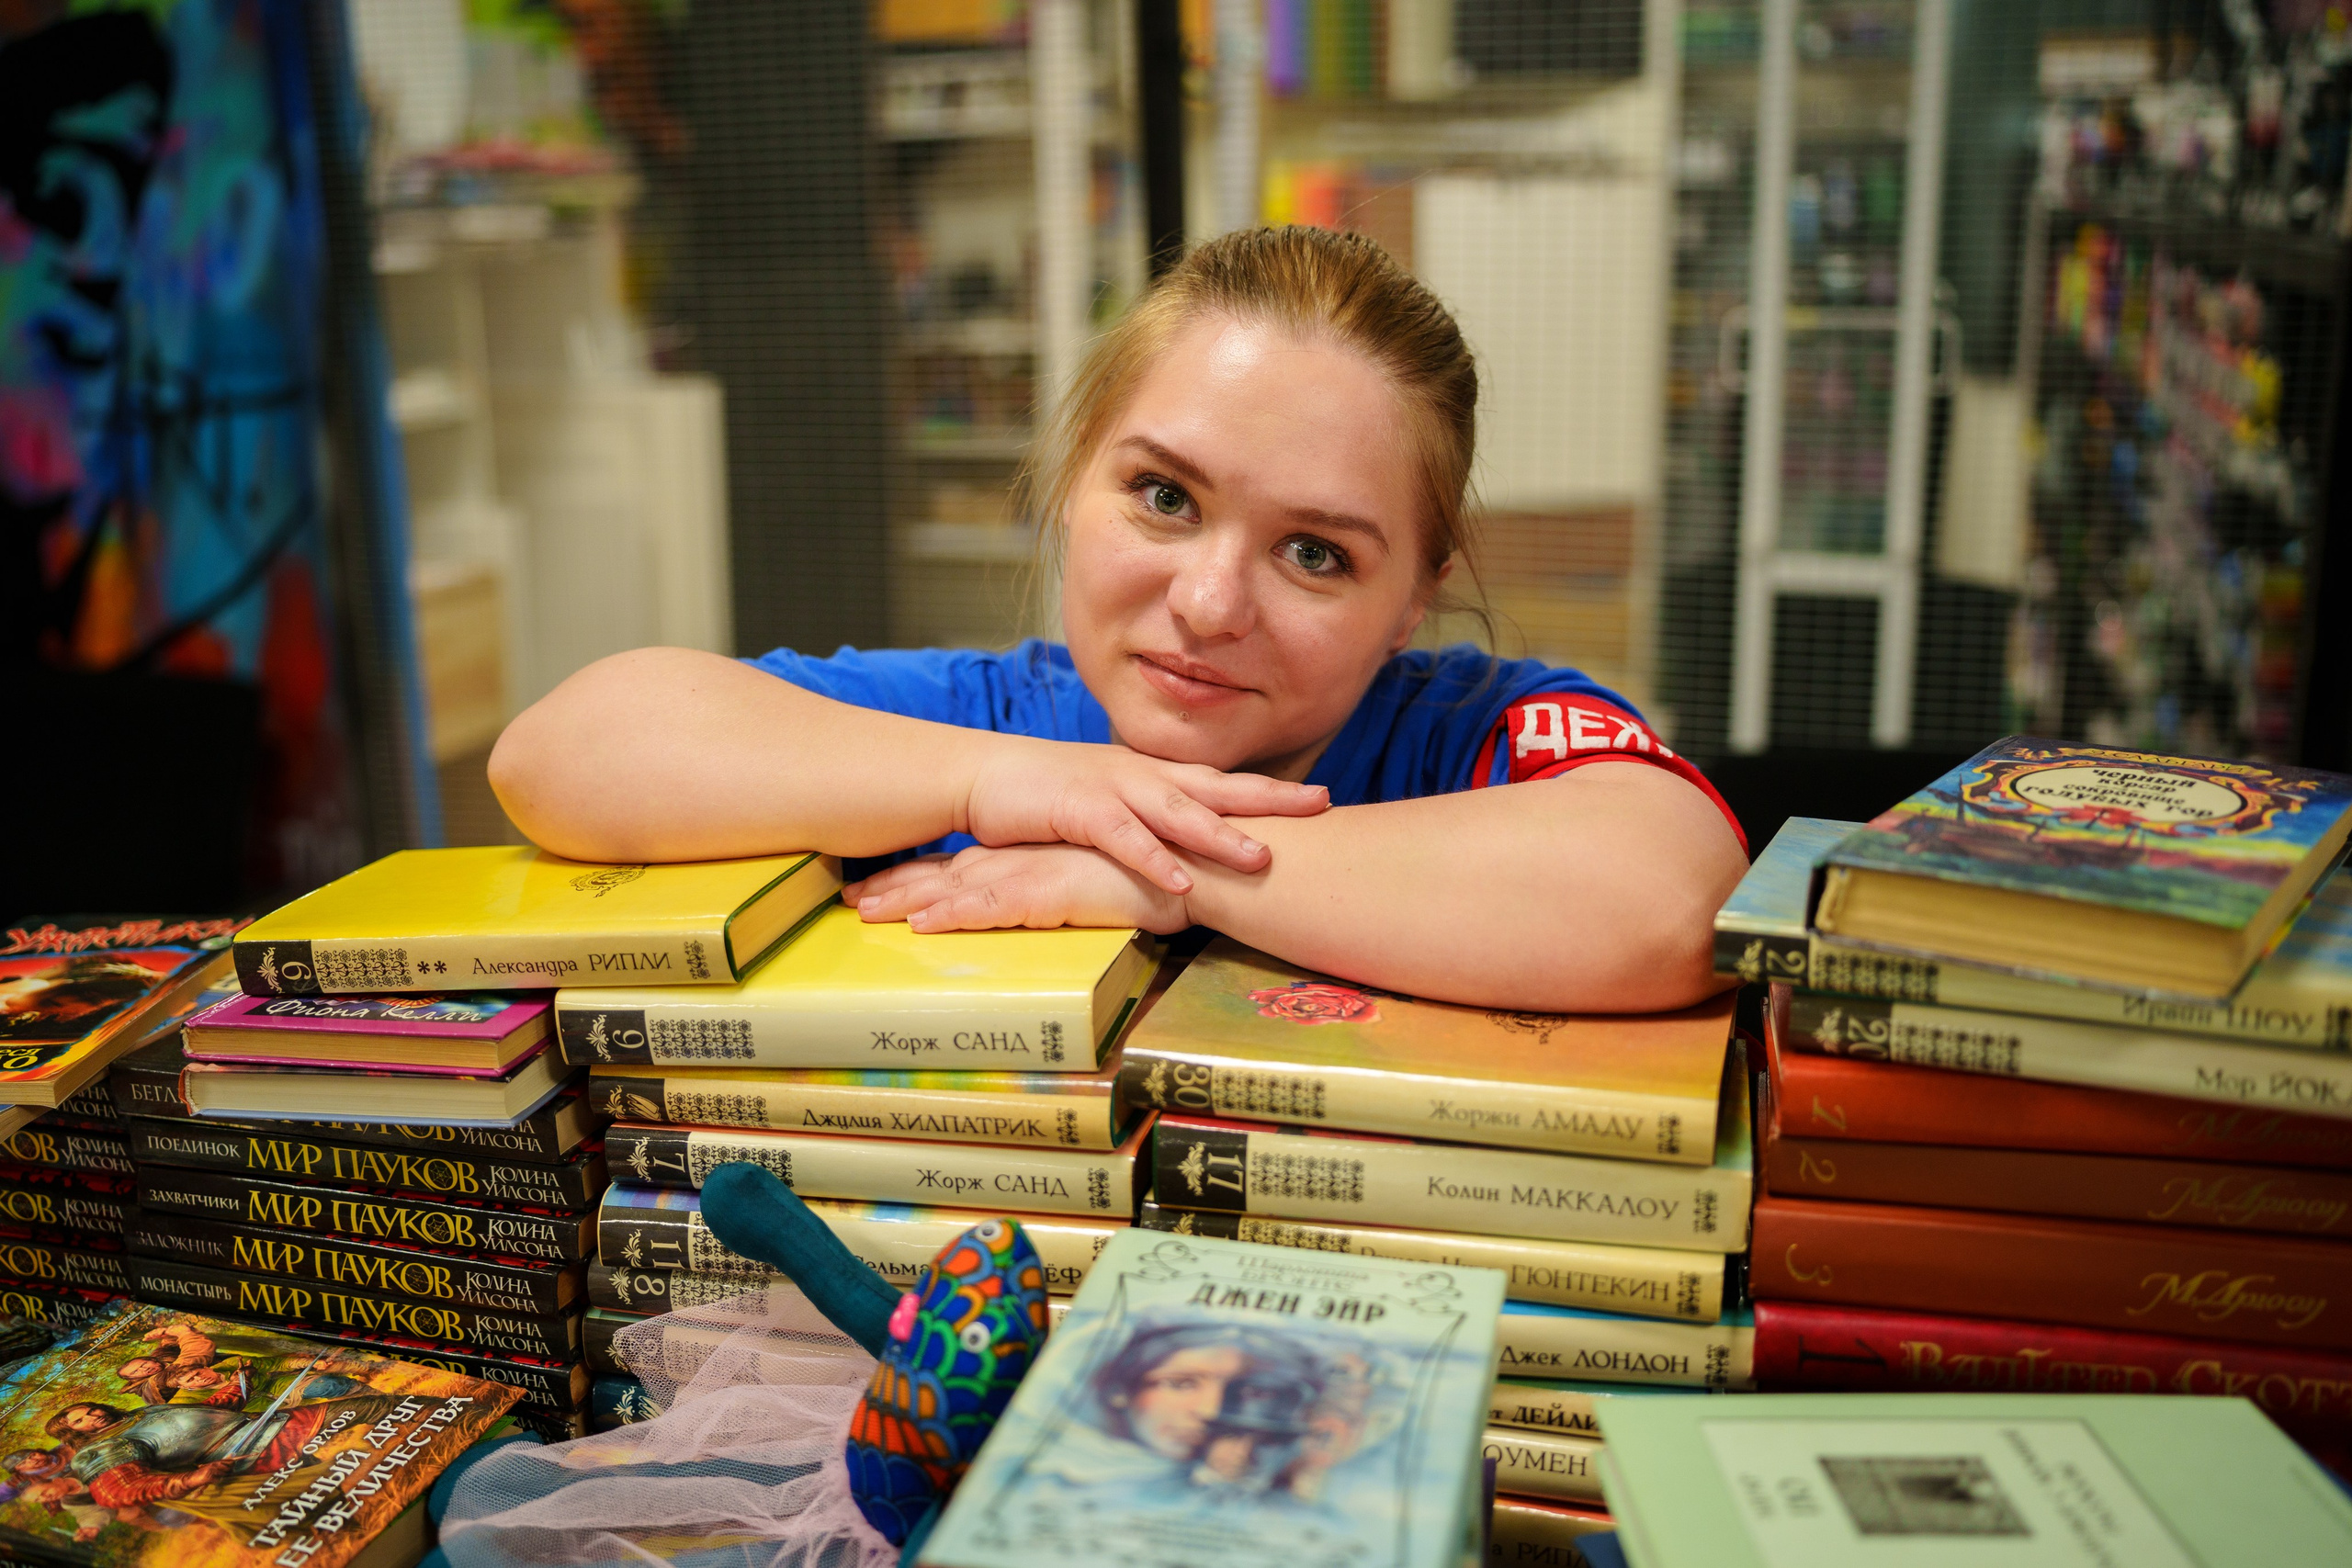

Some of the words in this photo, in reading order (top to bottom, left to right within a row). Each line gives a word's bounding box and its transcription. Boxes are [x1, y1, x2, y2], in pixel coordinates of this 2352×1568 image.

[1517, 702, 1673, 760] ДЕЖ
[472, 957, 579, 976] Александра
[587, 952, 673, 972] РИПЛИ
[265, 998, 370, 1019] Фиона
[380, 1003, 483, 1022] Келли
[870, 1031, 941, 1055] Жорж
[953, 1032, 1030, 1055] САНД
[130, 1083, 184, 1103] БЕГЛ
[2268, 1071, 2352, 1103] ЙОК
[802, 1108, 883, 1131] Джулия
[890, 1112, 1047, 1138] ХИЛПАТРИК
[1429, 1100, 1521, 1128] Жоржи
[1532, 1109, 1644, 1141] АМАДУ
[66, 1135, 127, 1156] КОЛИНА
[61, 1148, 135, 1174] УИЛСОНА
[147, 1135, 242, 1158] ПОЕДИНОК
[246, 1136, 322, 1176] МИР
[330, 1146, 480, 1194] ПАУКОВ
[490, 1165, 560, 1188] КОЛИНА
[916, 1168, 983, 1193] Жорж
[994, 1173, 1069, 1199] САНД
[481, 1179, 569, 1206] УИЛСОНА
[1427, 1176, 1500, 1201] Колин
[1510, 1185, 1679, 1221] МАККАЛОУ
[58, 1210, 124, 1234] УИЛСОН
[64, 1198, 124, 1220] КОЛИНА
[149, 1189, 240, 1211] ЗАХВАТЧИКИ
[247, 1190, 322, 1228] МИР
[331, 1199, 477, 1247] ПАУКОВ
[488, 1218, 558, 1241] КОЛИНА
[478, 1233, 565, 1259] УИЛСОНА
[64, 1252, 123, 1274] КОЛИНА
[136, 1230, 226, 1258] ЗАЛОЖНИК
[232, 1235, 305, 1274] МИР
[312, 1247, 454, 1299] ПАУКОВ
[465, 1270, 533, 1296] КОЛИНА
[1510, 1263, 1672, 1303] ГЮНТЕКИН
[53, 1300, 94, 1319] КОЛИ
[141, 1275, 232, 1301] МОНАСТЫРЬ
[237, 1280, 312, 1319] МИР
[319, 1292, 465, 1342] ПАУКОВ
[456, 1284, 540, 1314] УИЛСОНА
[1186, 1282, 1301, 1314] ДЖЕН
[1313, 1294, 1386, 1323] ЭЙР
[474, 1314, 543, 1338] КОЛИНА
[466, 1326, 551, 1355] УИЛСОНА
[1498, 1346, 1563, 1366] Джек
[1573, 1349, 1690, 1374] ЛОНДОН
[481, 1366, 549, 1390] КОЛИНА
[242, 1457, 304, 1511] АЛЕКС
[302, 1409, 356, 1455] ОРЛОВ
[248, 1448, 371, 1548] ТАЙНЫЙ
[364, 1395, 424, 1450] ДРУГ
[1482, 1444, 1588, 1476] ОУМЕН
[276, 1535, 322, 1568] ЕЕ
[313, 1394, 474, 1533] ВЕЛИЧЕСТВА
